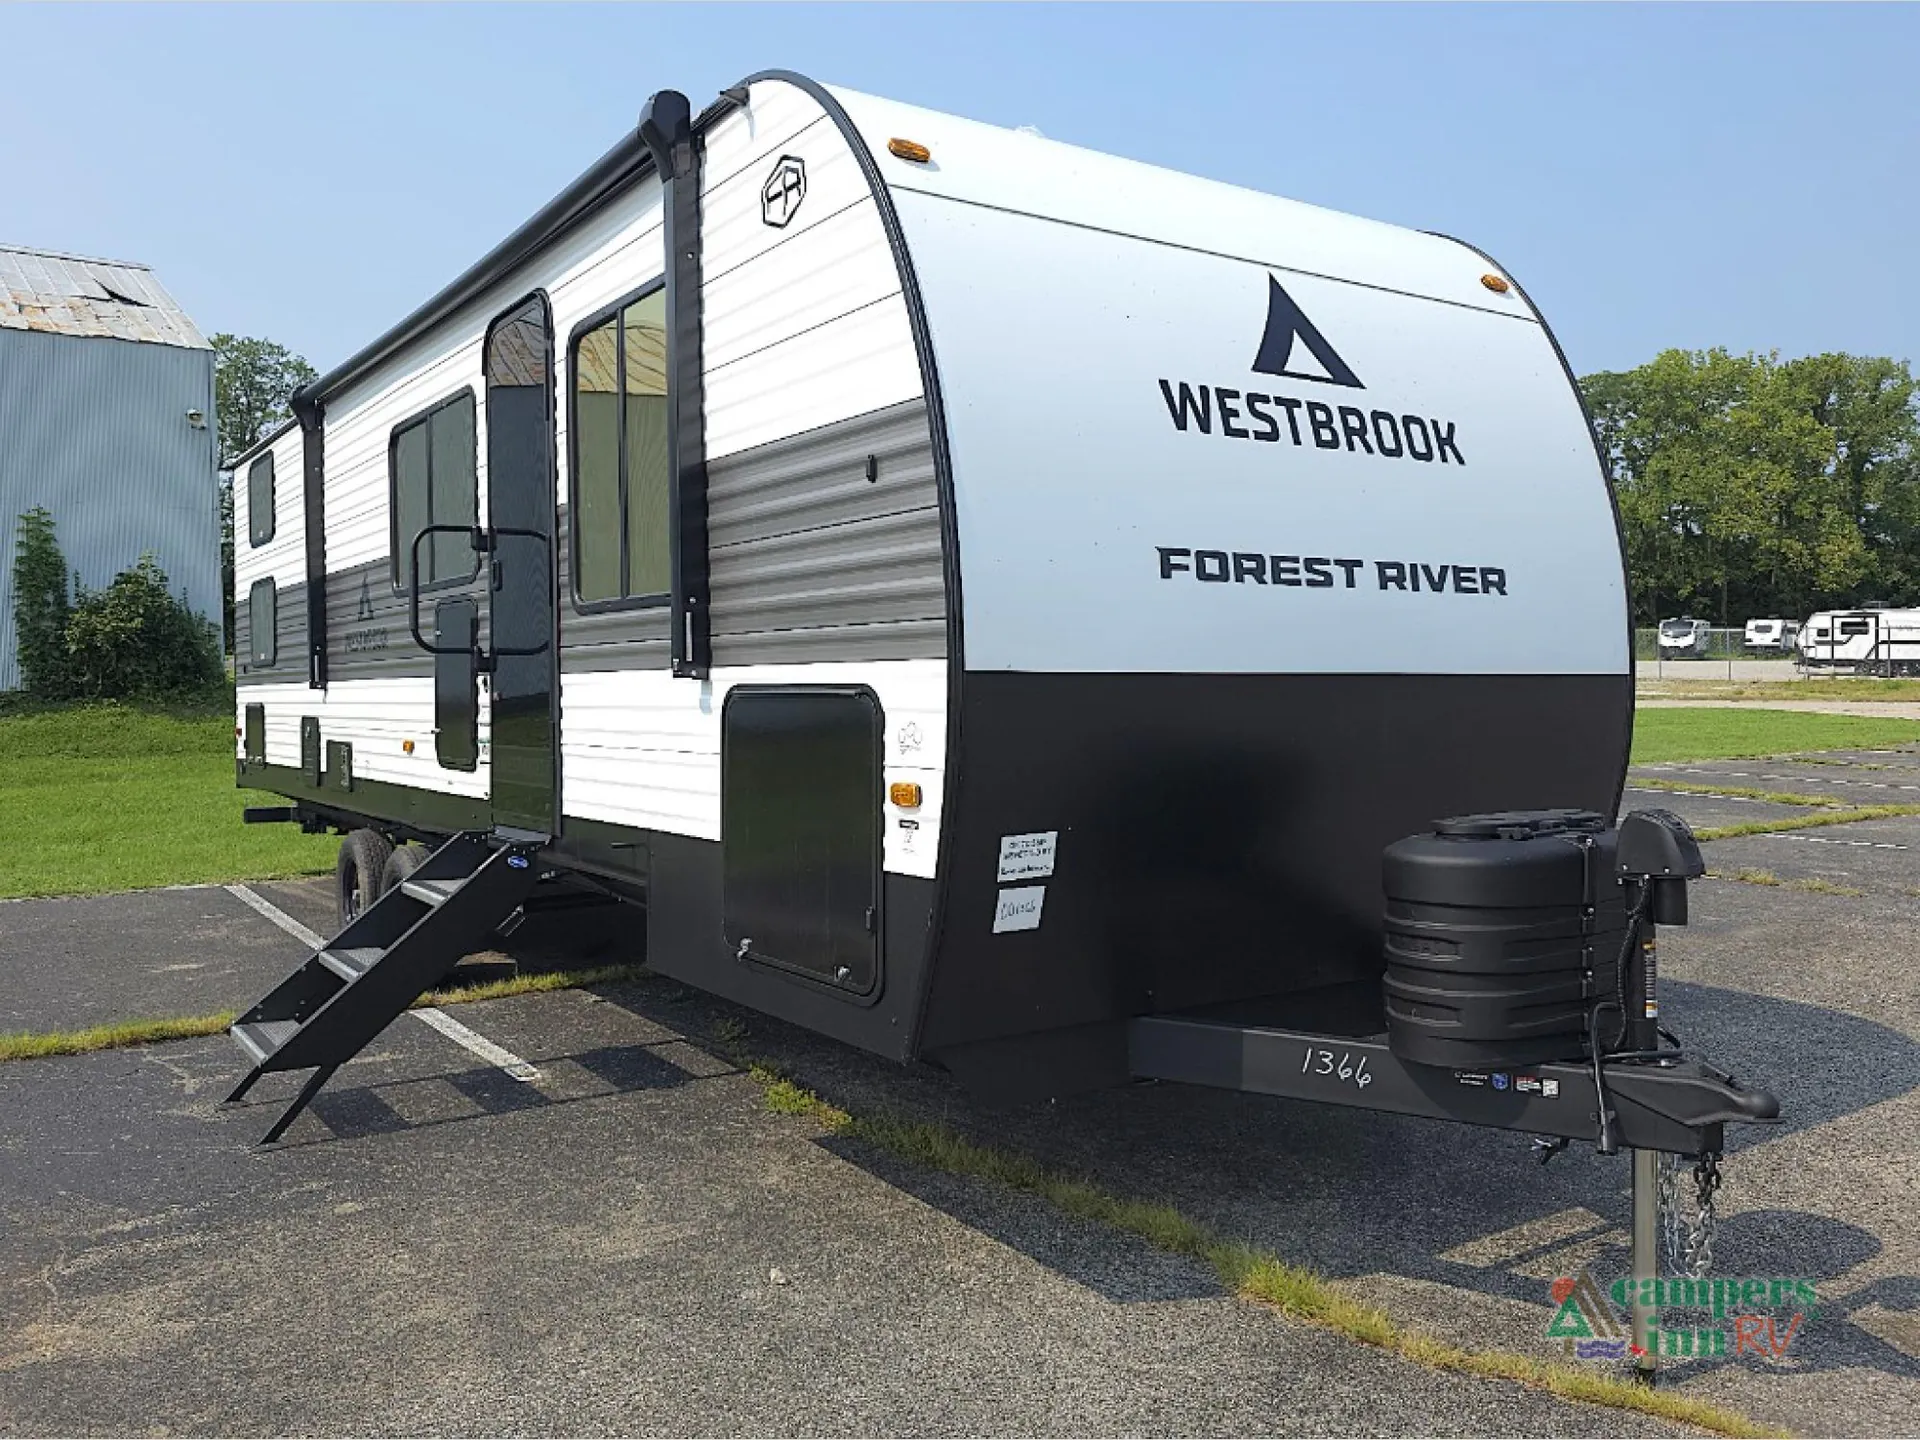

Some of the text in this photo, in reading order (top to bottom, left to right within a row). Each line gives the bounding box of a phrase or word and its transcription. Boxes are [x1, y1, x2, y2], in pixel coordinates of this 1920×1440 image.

[1158, 378, 1466, 466] WESTBROOK
[1155, 546, 1508, 596] FOREST RIVER
[1300, 1046, 1372, 1089] 1366
